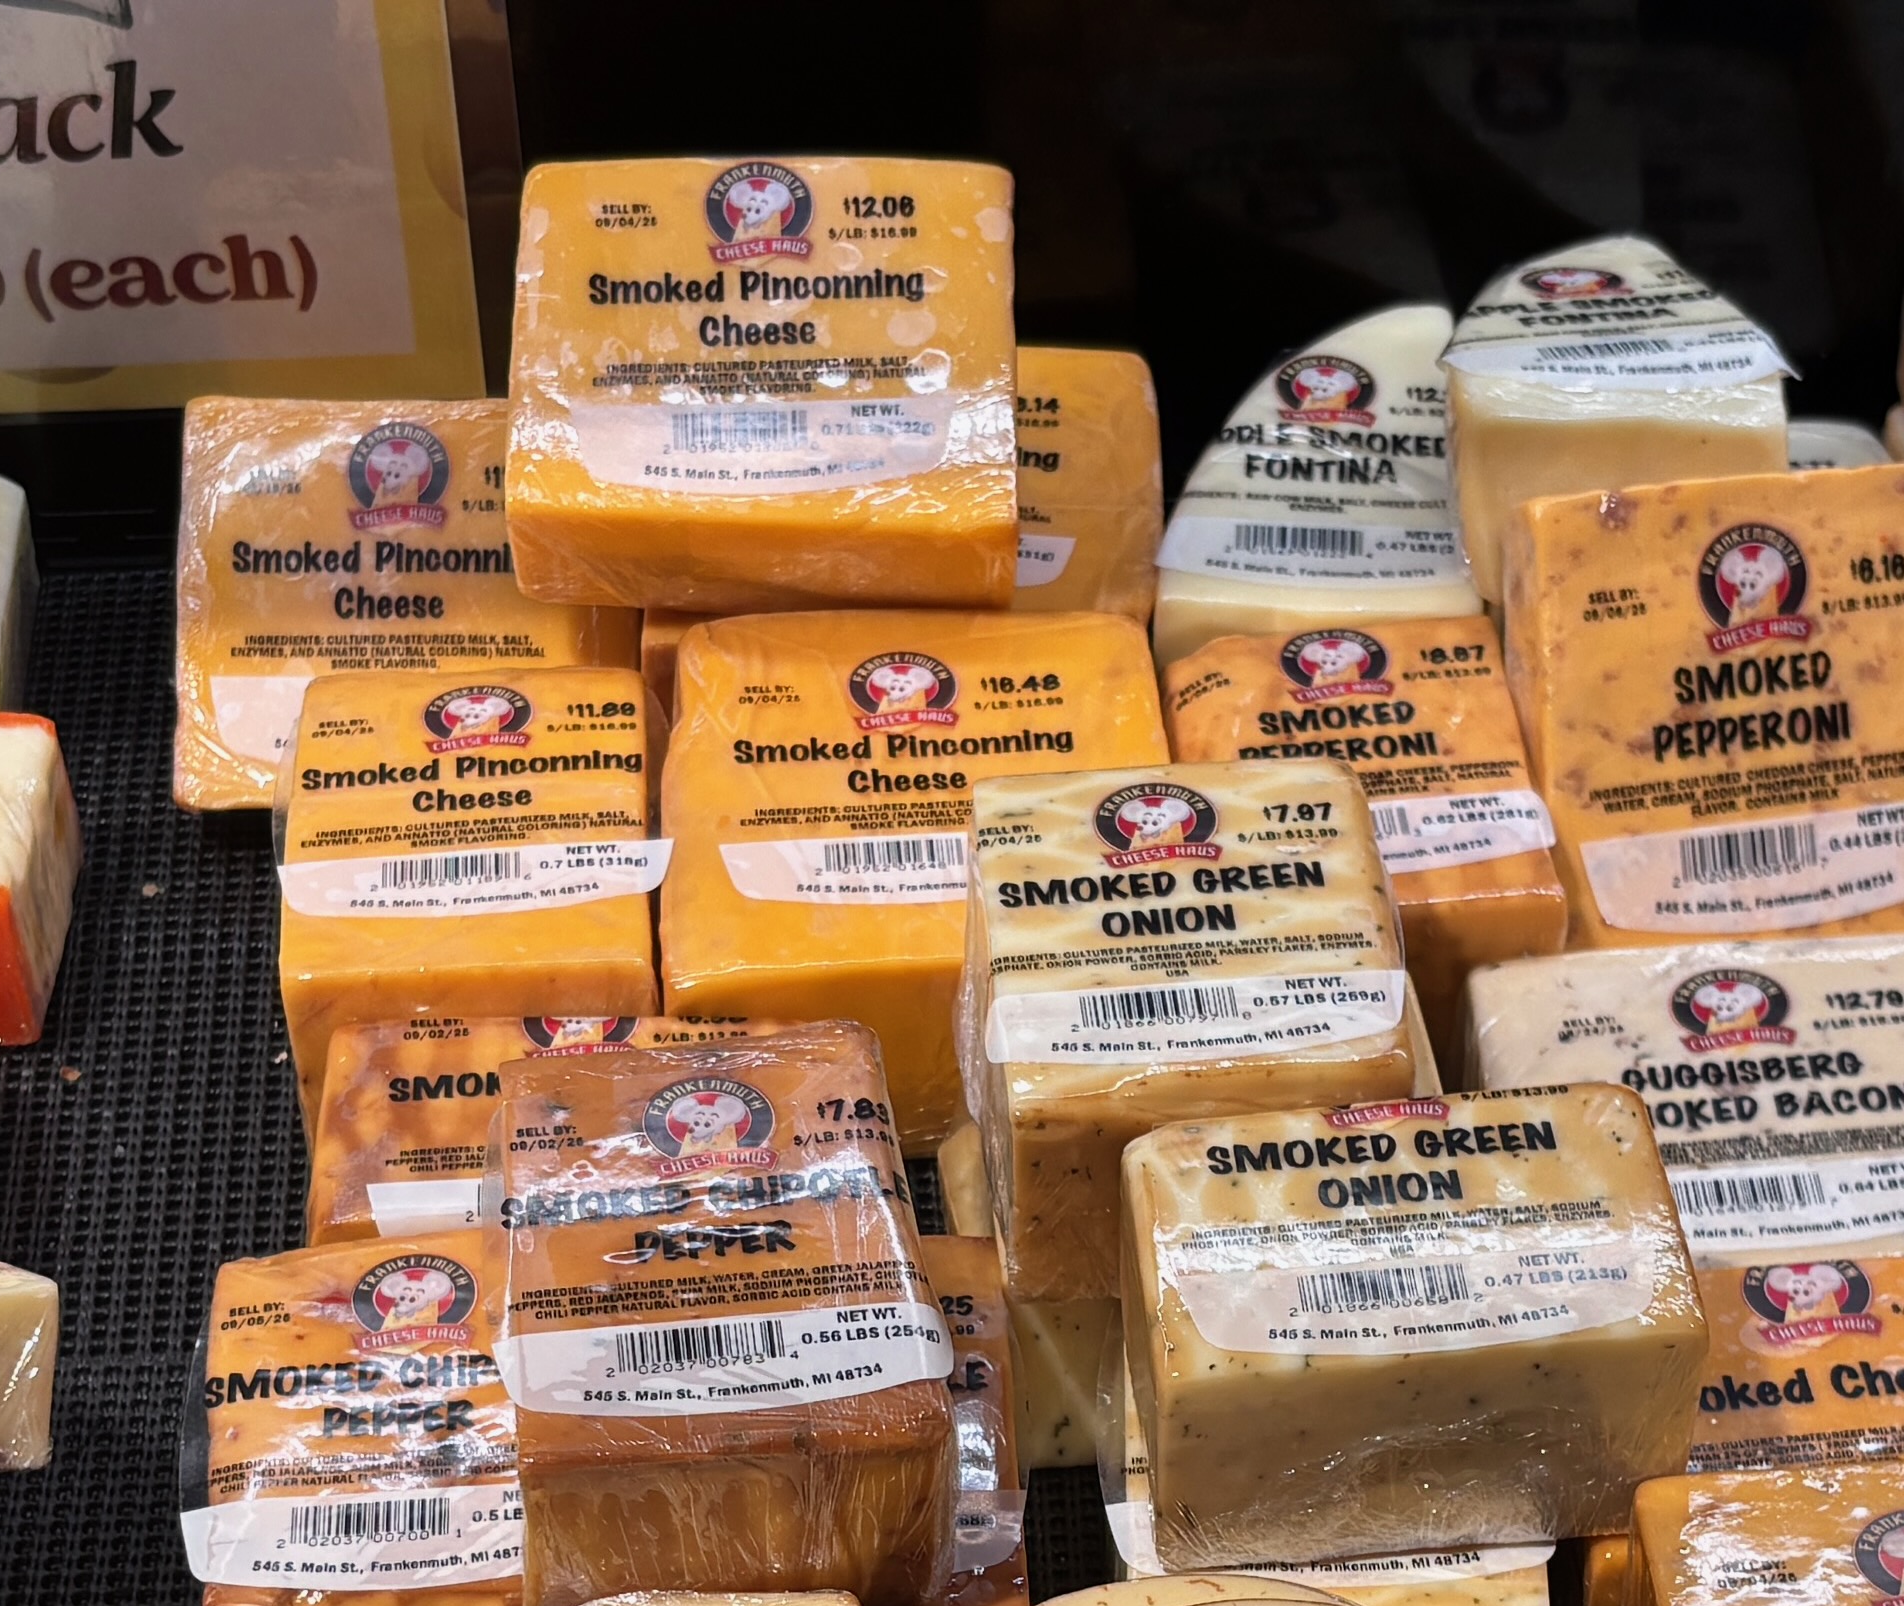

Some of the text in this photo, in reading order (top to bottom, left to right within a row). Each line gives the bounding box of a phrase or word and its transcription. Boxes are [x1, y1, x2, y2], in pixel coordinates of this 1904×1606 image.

[29, 234, 319, 322] (each)
[589, 267, 925, 305] Smoked Pinconning
[699, 315, 817, 346] Cheese
[1246, 455, 1396, 484] FONTINA
[232, 542, 360, 574] Smoked
[335, 587, 444, 620] Cheese
[1674, 650, 1831, 704] SMOKED
[1257, 700, 1416, 737] SMOKED
[1653, 701, 1852, 763] PEPPERONI
[734, 729, 1074, 764] Smoked Pinconning
[302, 751, 642, 791] Smoked Pinconning
[847, 768, 967, 794] Cheese
[413, 789, 532, 812] Cheese
[998, 860, 1325, 908] SMOKED GREEN
[1102, 904, 1236, 938] ONION
[1206, 1121, 1558, 1176] SMOKED GREEN
[1318, 1169, 1463, 1209] ONION
[634, 1221, 796, 1260] PEPPER
[205, 1362, 383, 1408] SMOKED
[322, 1400, 475, 1437] PEPPER
